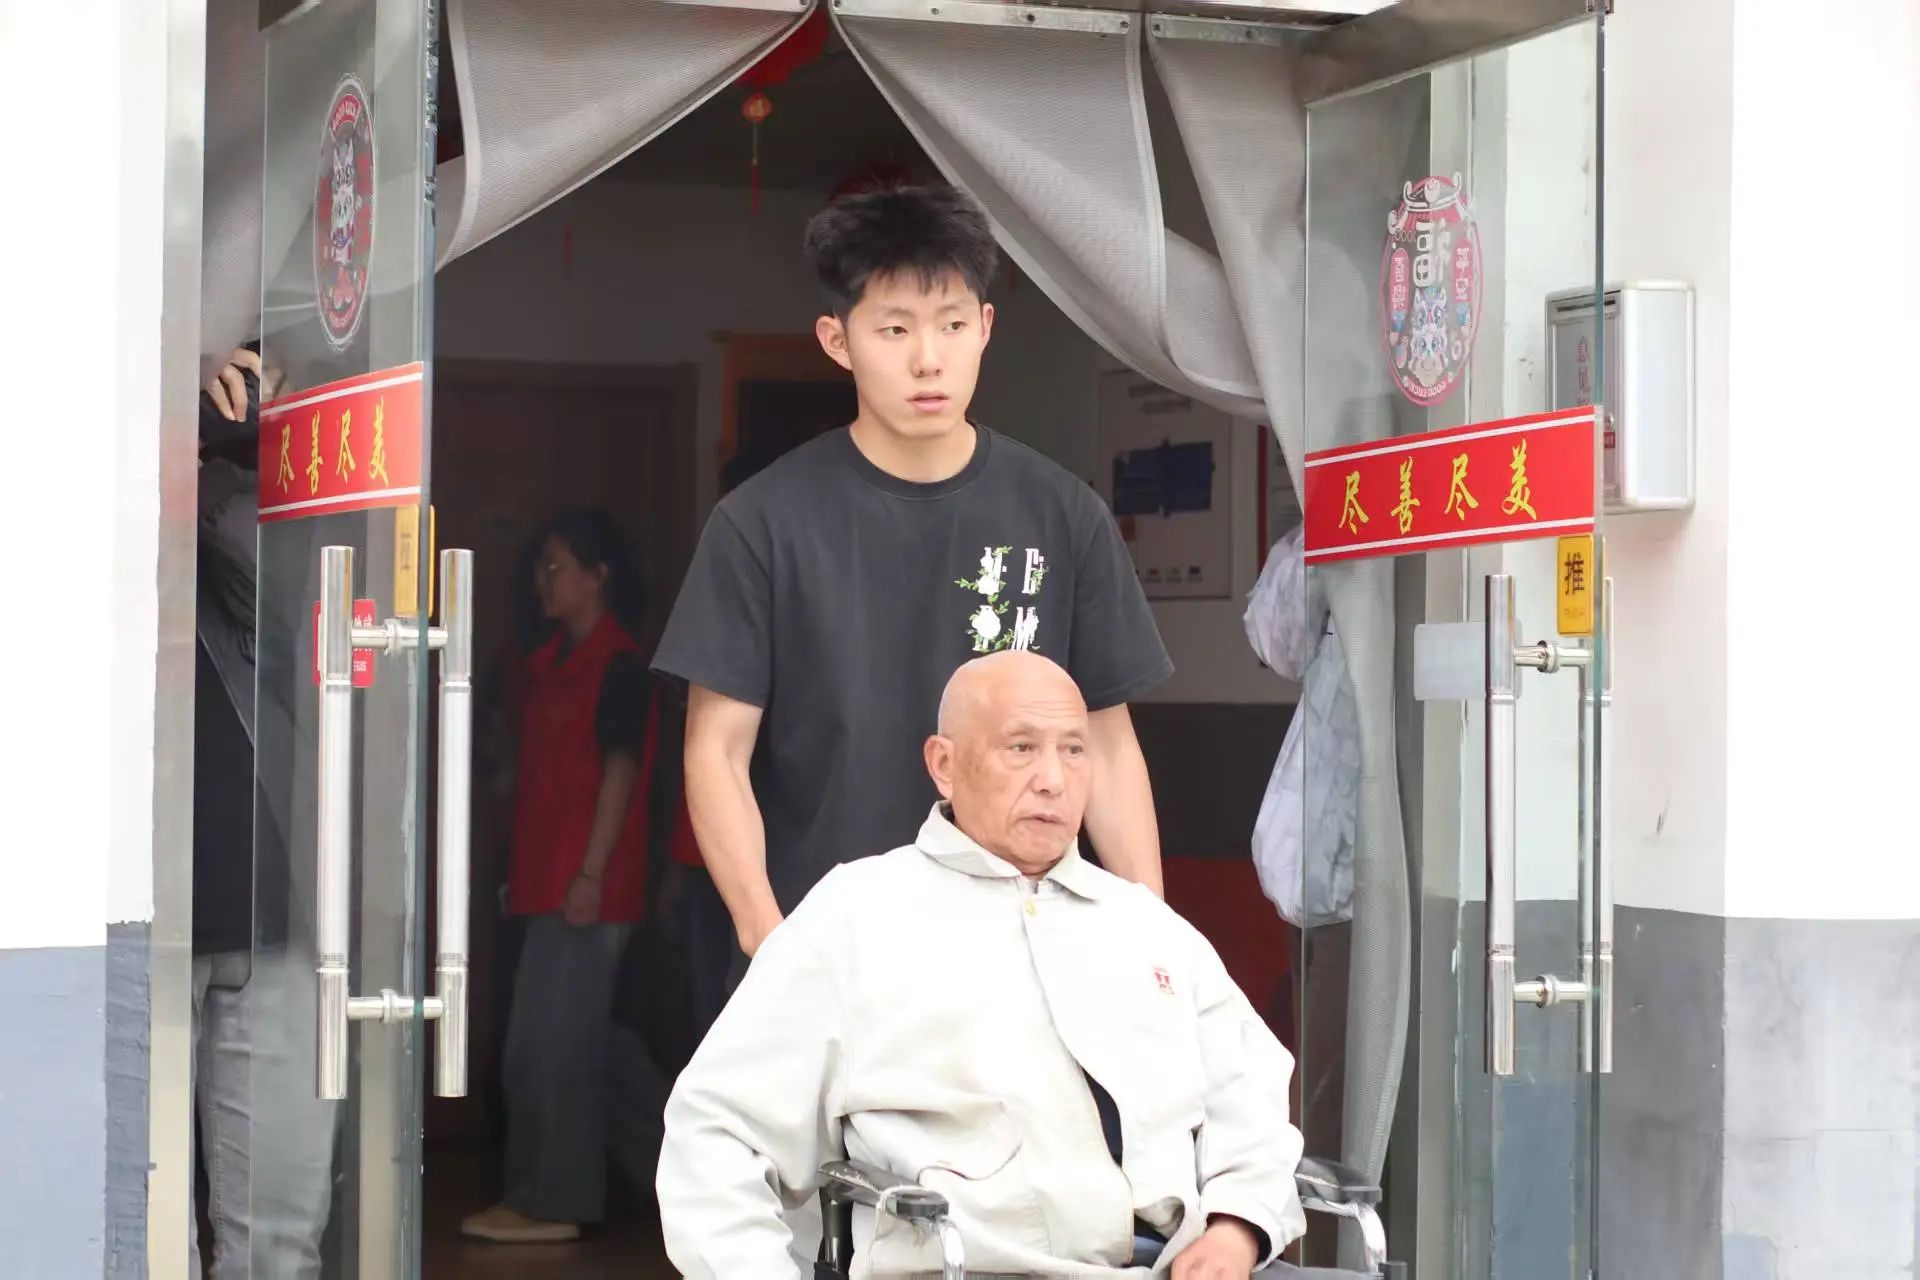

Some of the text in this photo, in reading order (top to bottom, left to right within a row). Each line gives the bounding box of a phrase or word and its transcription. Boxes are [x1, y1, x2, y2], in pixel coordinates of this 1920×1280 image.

[277, 394, 389, 496] 尽善尽美
[1338, 437, 1537, 535] 尽善尽美
[1564, 552, 1585, 597] 推
